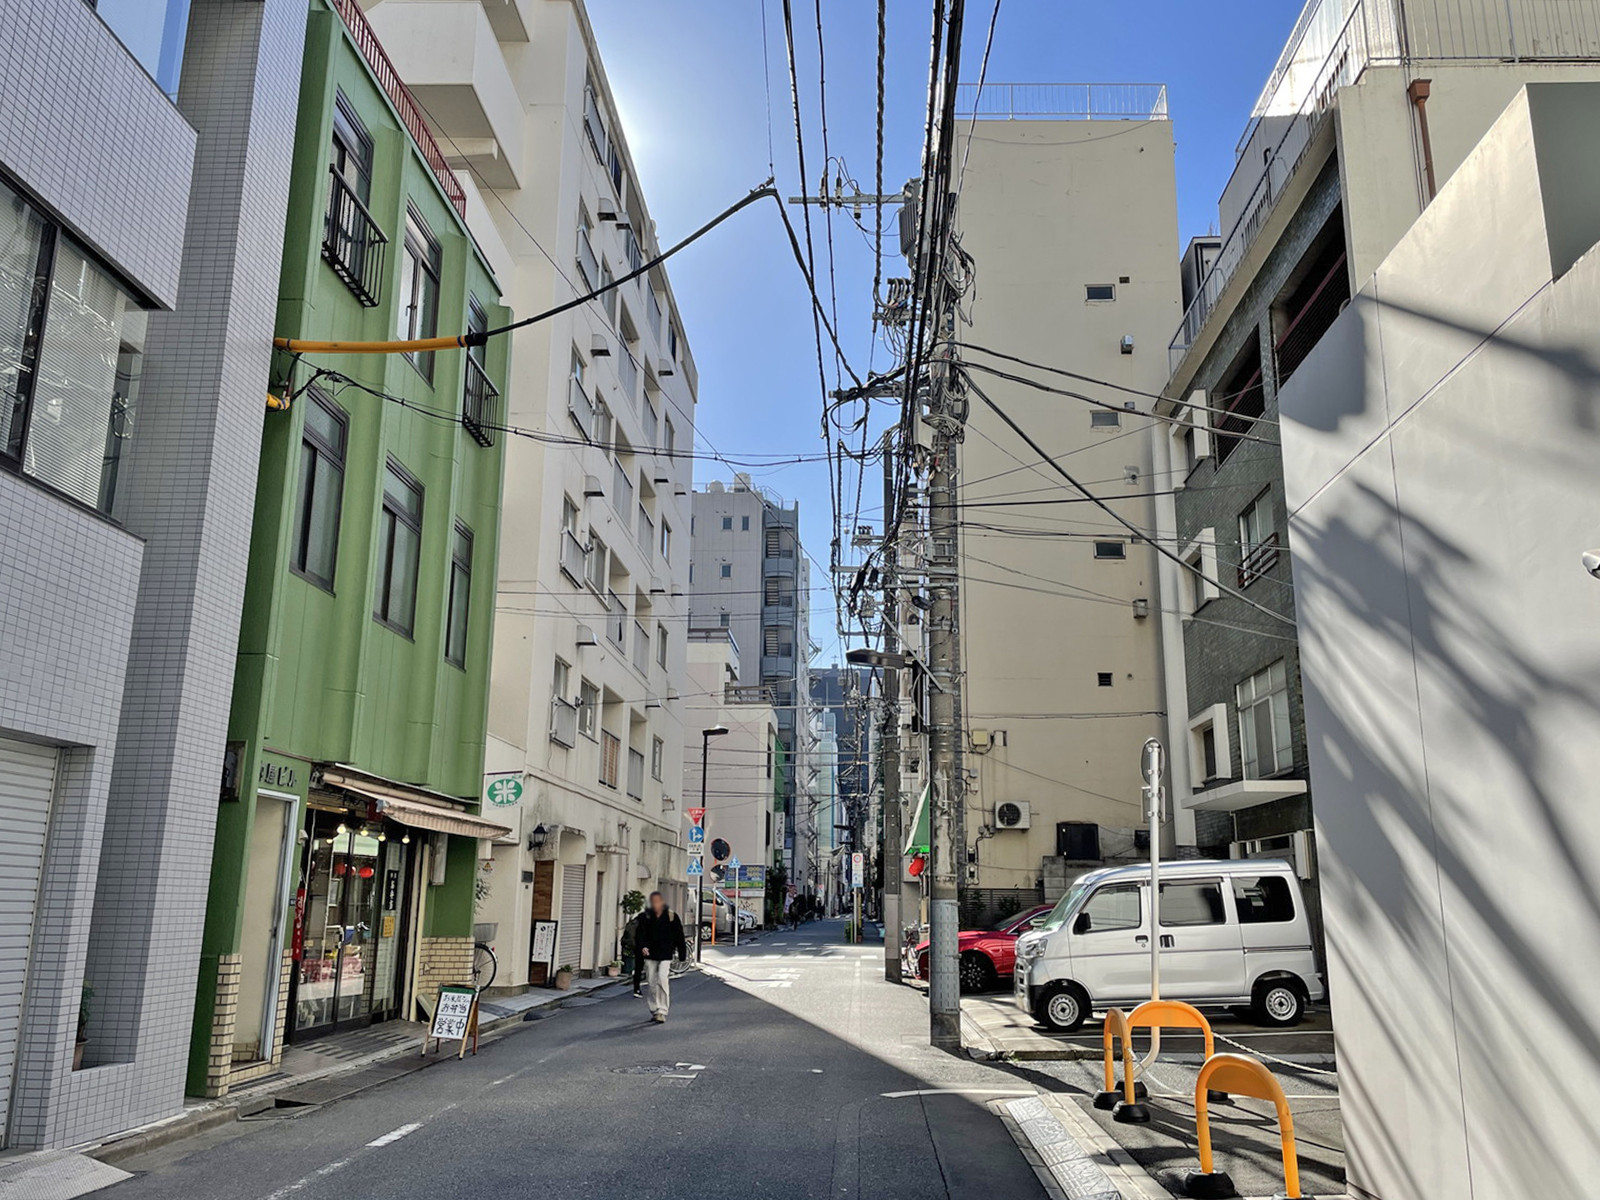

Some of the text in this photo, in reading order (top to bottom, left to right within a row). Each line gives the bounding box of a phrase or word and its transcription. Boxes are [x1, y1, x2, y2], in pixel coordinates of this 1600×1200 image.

[440, 1003, 467, 1014] お弁当
[436, 1017, 465, 1036] 営業中
